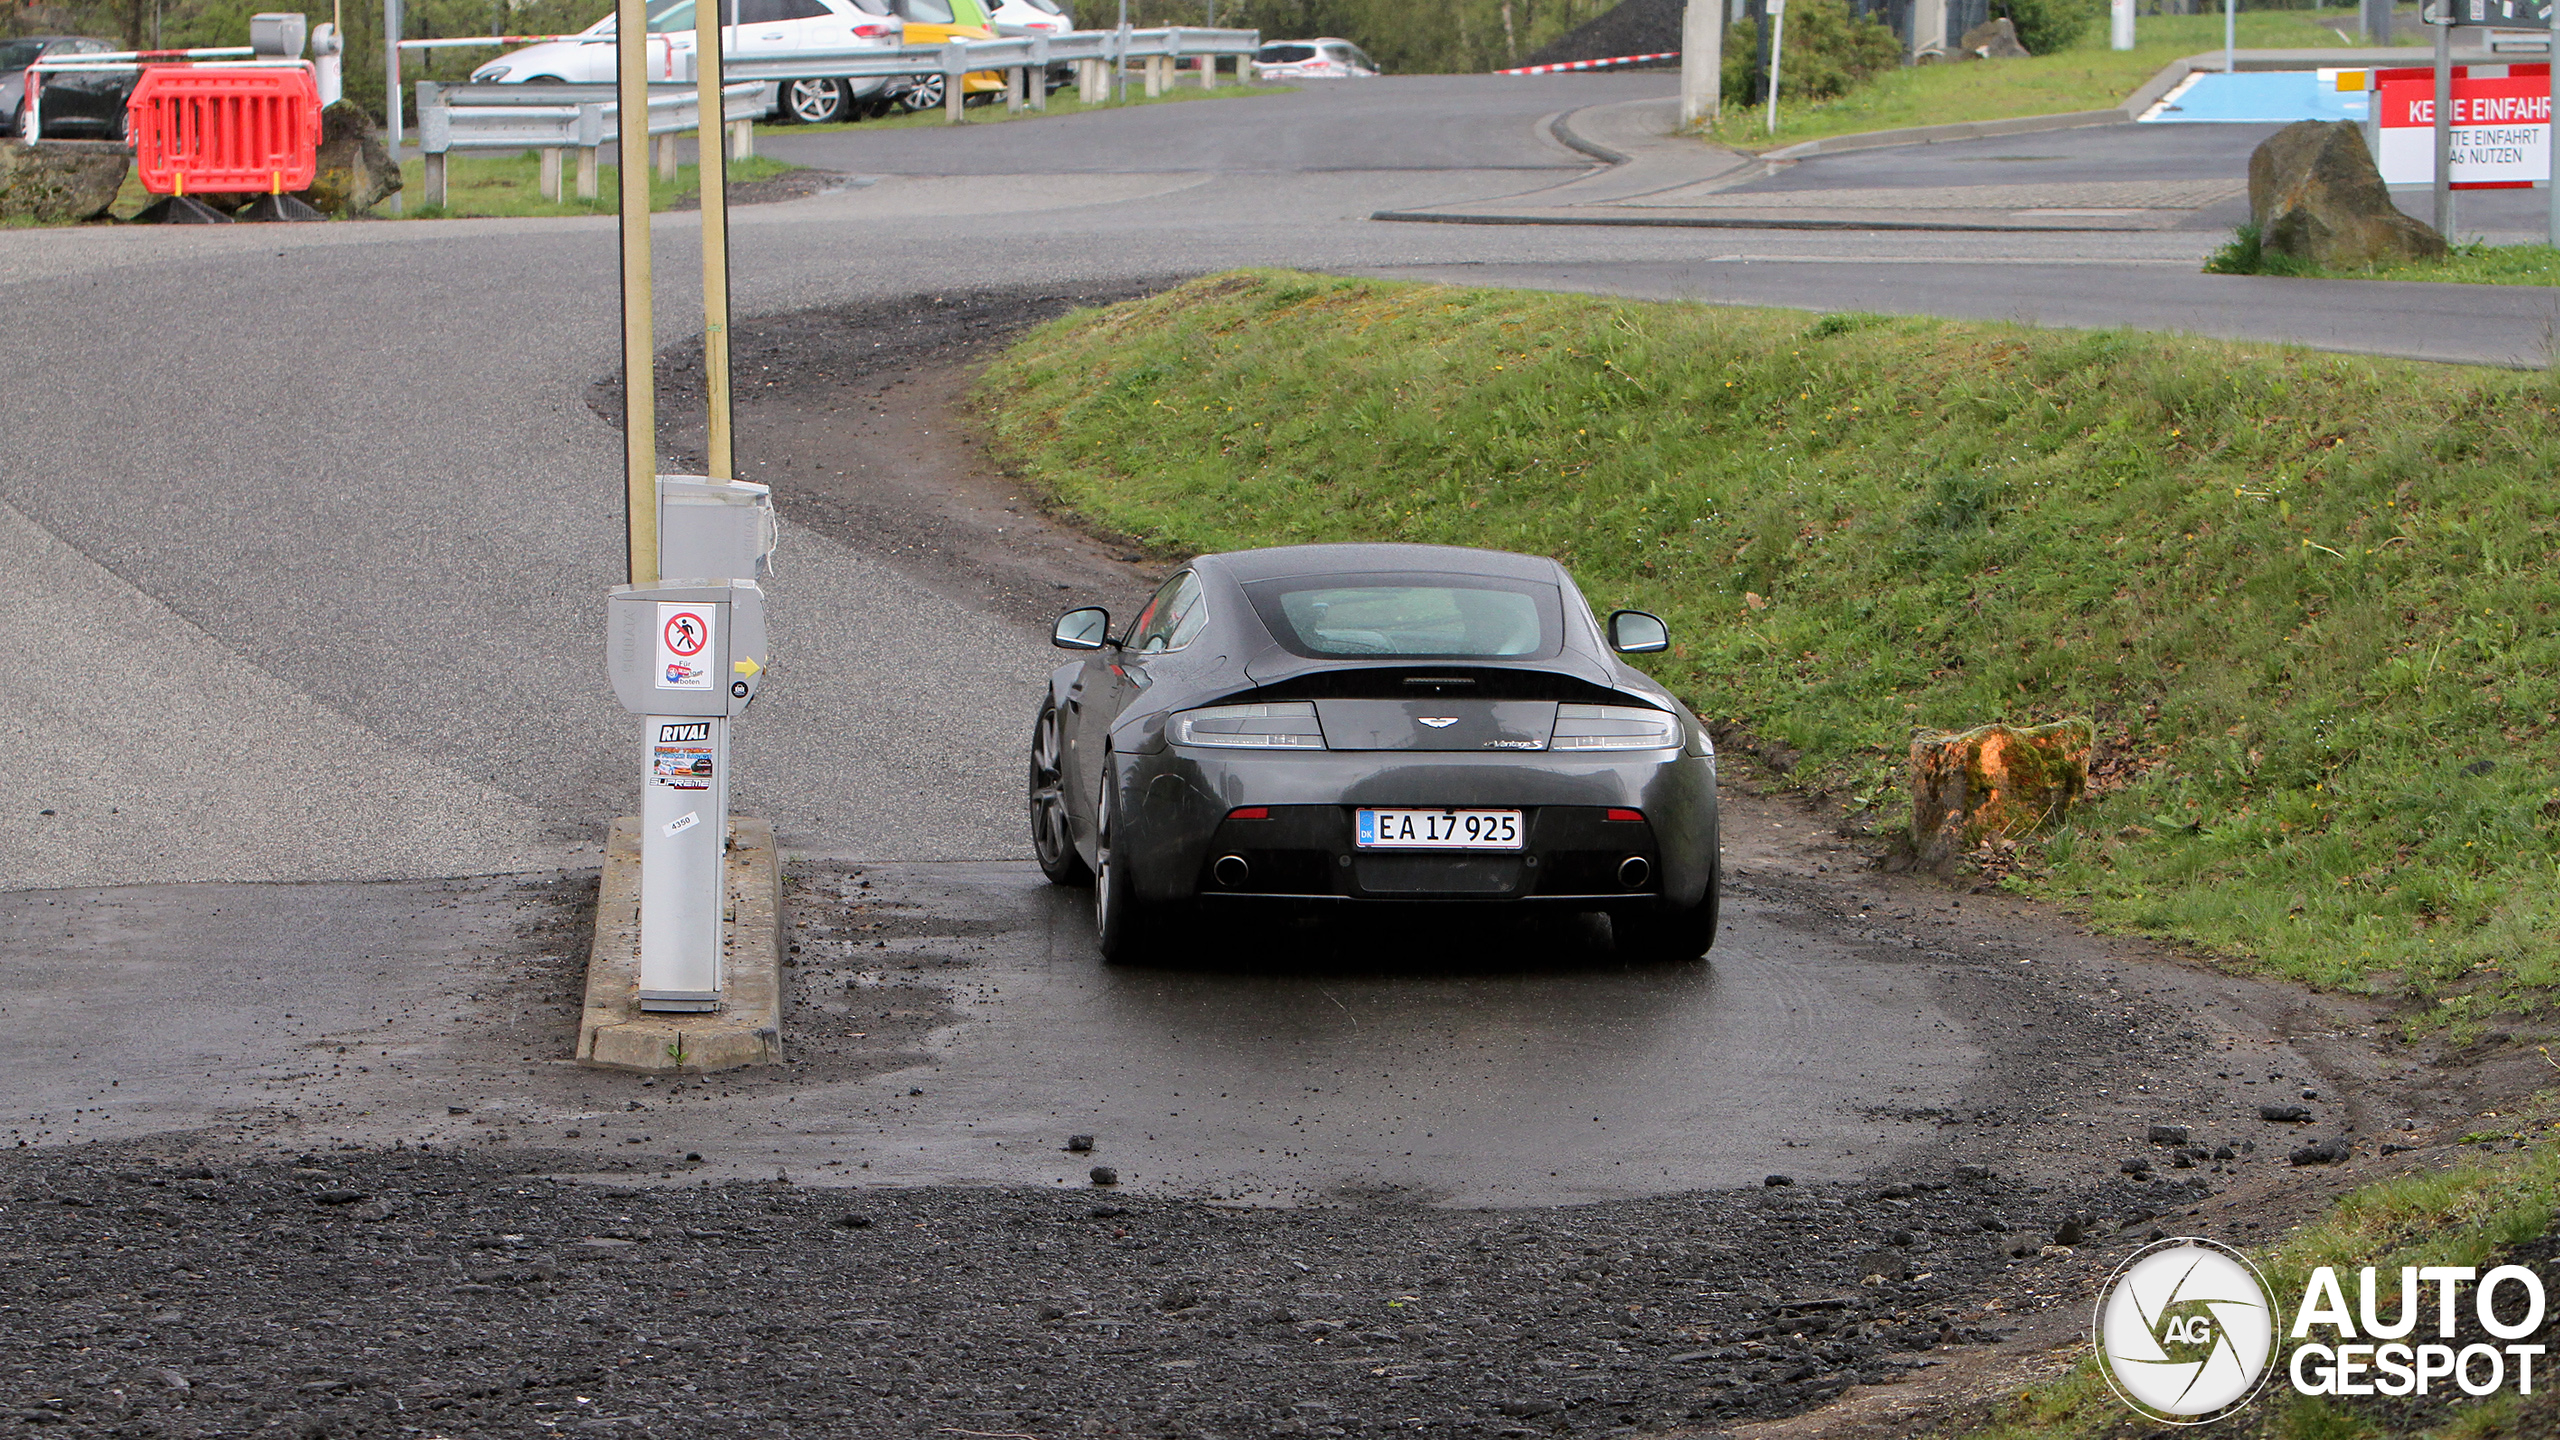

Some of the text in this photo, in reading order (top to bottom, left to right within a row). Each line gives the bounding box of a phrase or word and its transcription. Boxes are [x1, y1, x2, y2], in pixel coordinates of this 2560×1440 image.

[2409, 97, 2552, 122] KEE EINFAHR
[2449, 128, 2540, 146] TTE EINFAHRT
[2470, 148, 2523, 164] NUTZEN
[661, 724, 707, 742] RIVAL
[650, 777, 711, 788] SUPREME
[671, 816, 691, 830] 4350
[1380, 815, 1516, 842] EA 17 925
[1361, 830, 1372, 839] DK
